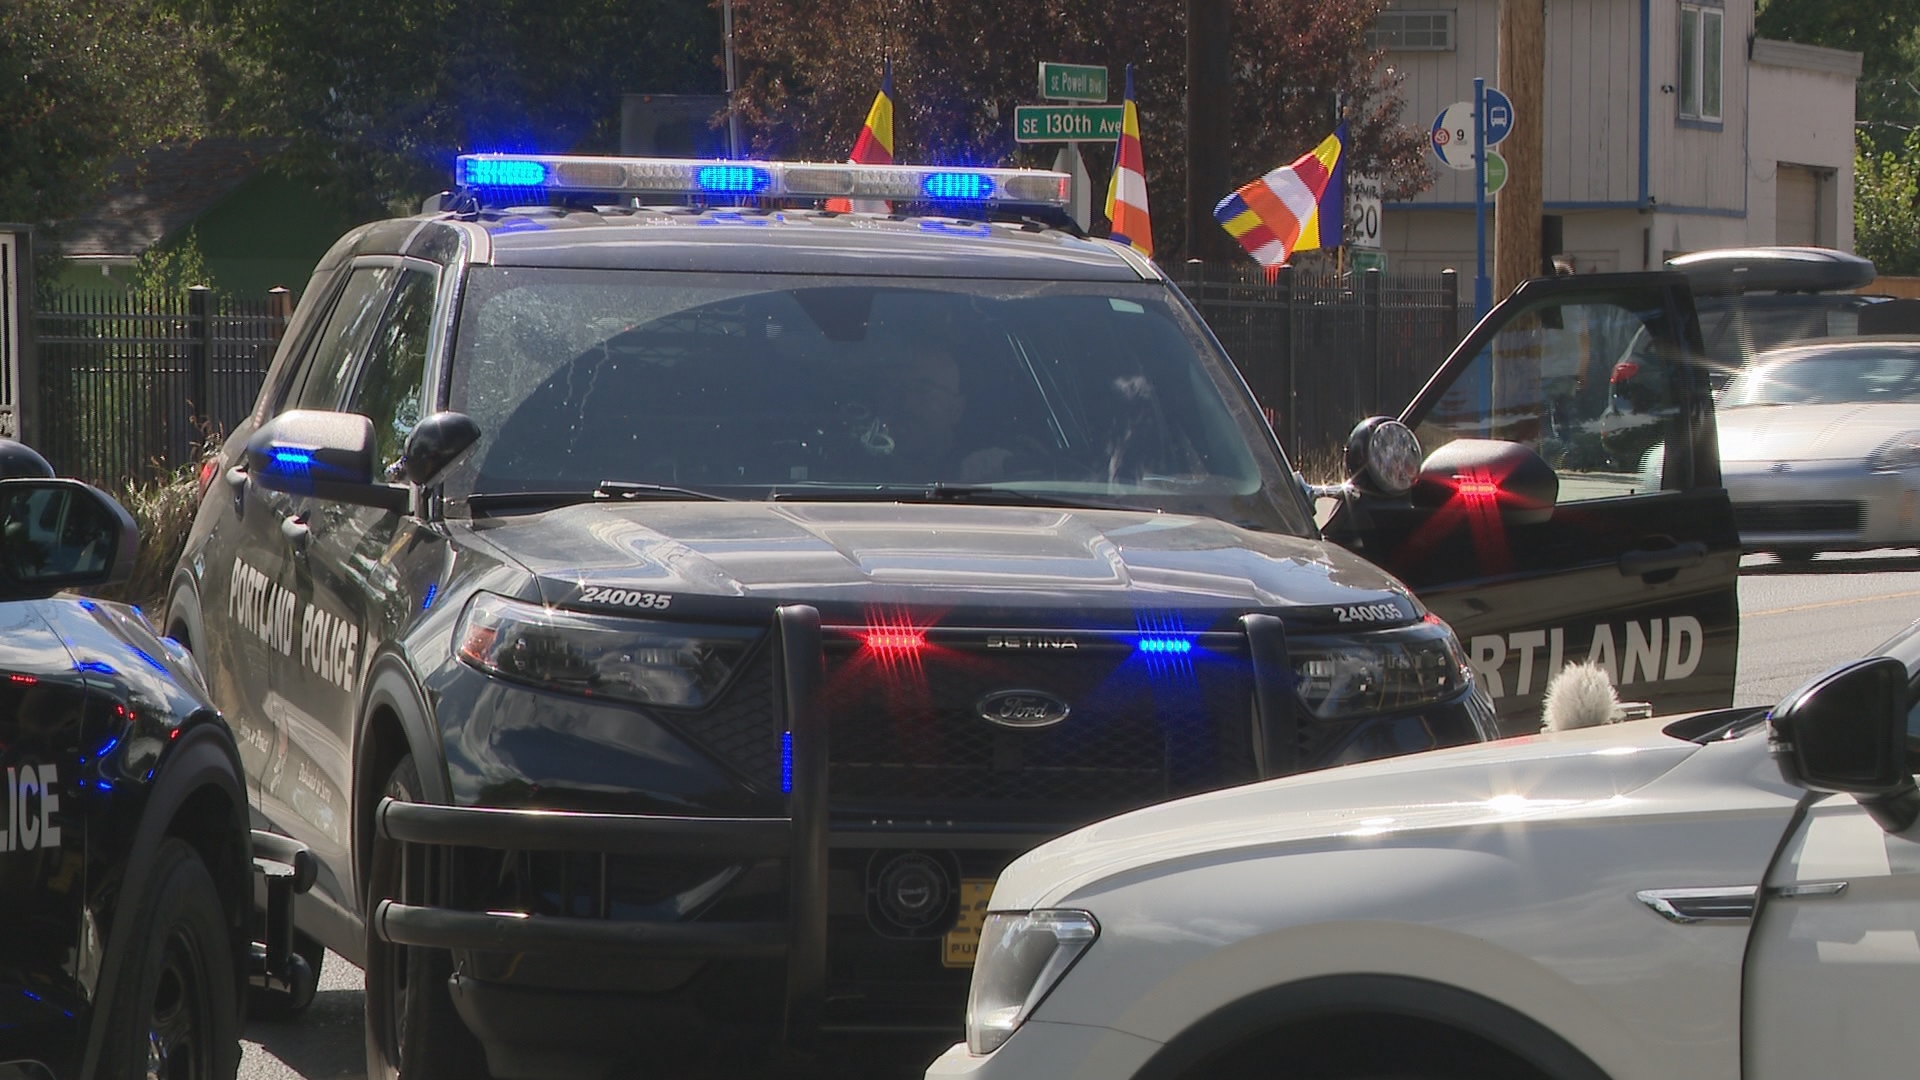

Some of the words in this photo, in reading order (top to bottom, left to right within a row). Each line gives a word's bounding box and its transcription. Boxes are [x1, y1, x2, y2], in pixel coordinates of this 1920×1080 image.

[1051, 75, 1059, 91] SE
[1062, 72, 1087, 93] Powell
[1022, 118, 1038, 134] SE
[1046, 113, 1092, 134] 130th
[1099, 119, 1121, 134] Ave
[1456, 129, 1465, 141] 9
[1352, 203, 1378, 239] 20
[579, 586, 673, 610] 240035
[1333, 603, 1403, 622] 240035
[229, 556, 296, 657] PORTLAND
[301, 603, 359, 693] POLICE
[986, 636, 1078, 649] SETINA
[1000, 697, 1049, 718] Ford
